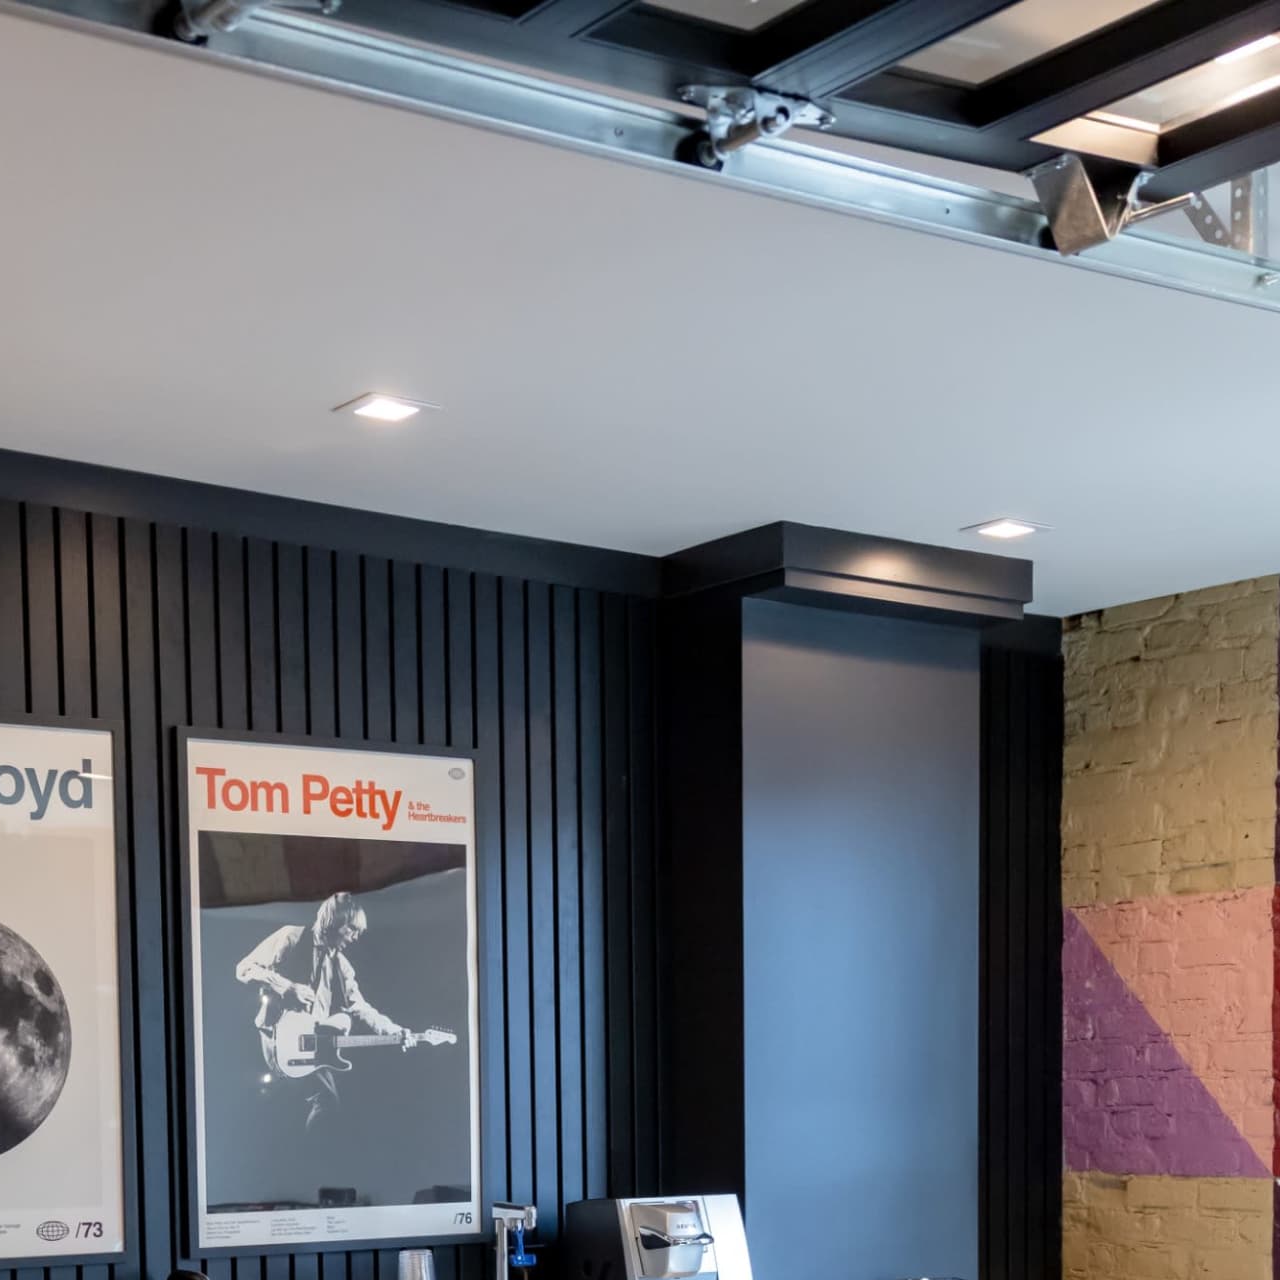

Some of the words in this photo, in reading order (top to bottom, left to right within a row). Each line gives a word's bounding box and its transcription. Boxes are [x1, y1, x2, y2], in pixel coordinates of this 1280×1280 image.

[195, 766, 289, 814] Tom
[302, 774, 402, 831] Petty
[407, 801, 415, 810] &
[416, 801, 431, 811] the
[407, 811, 467, 824] Heartbreakers
[452, 1212, 473, 1225] /76
[75, 1221, 104, 1239] /73
